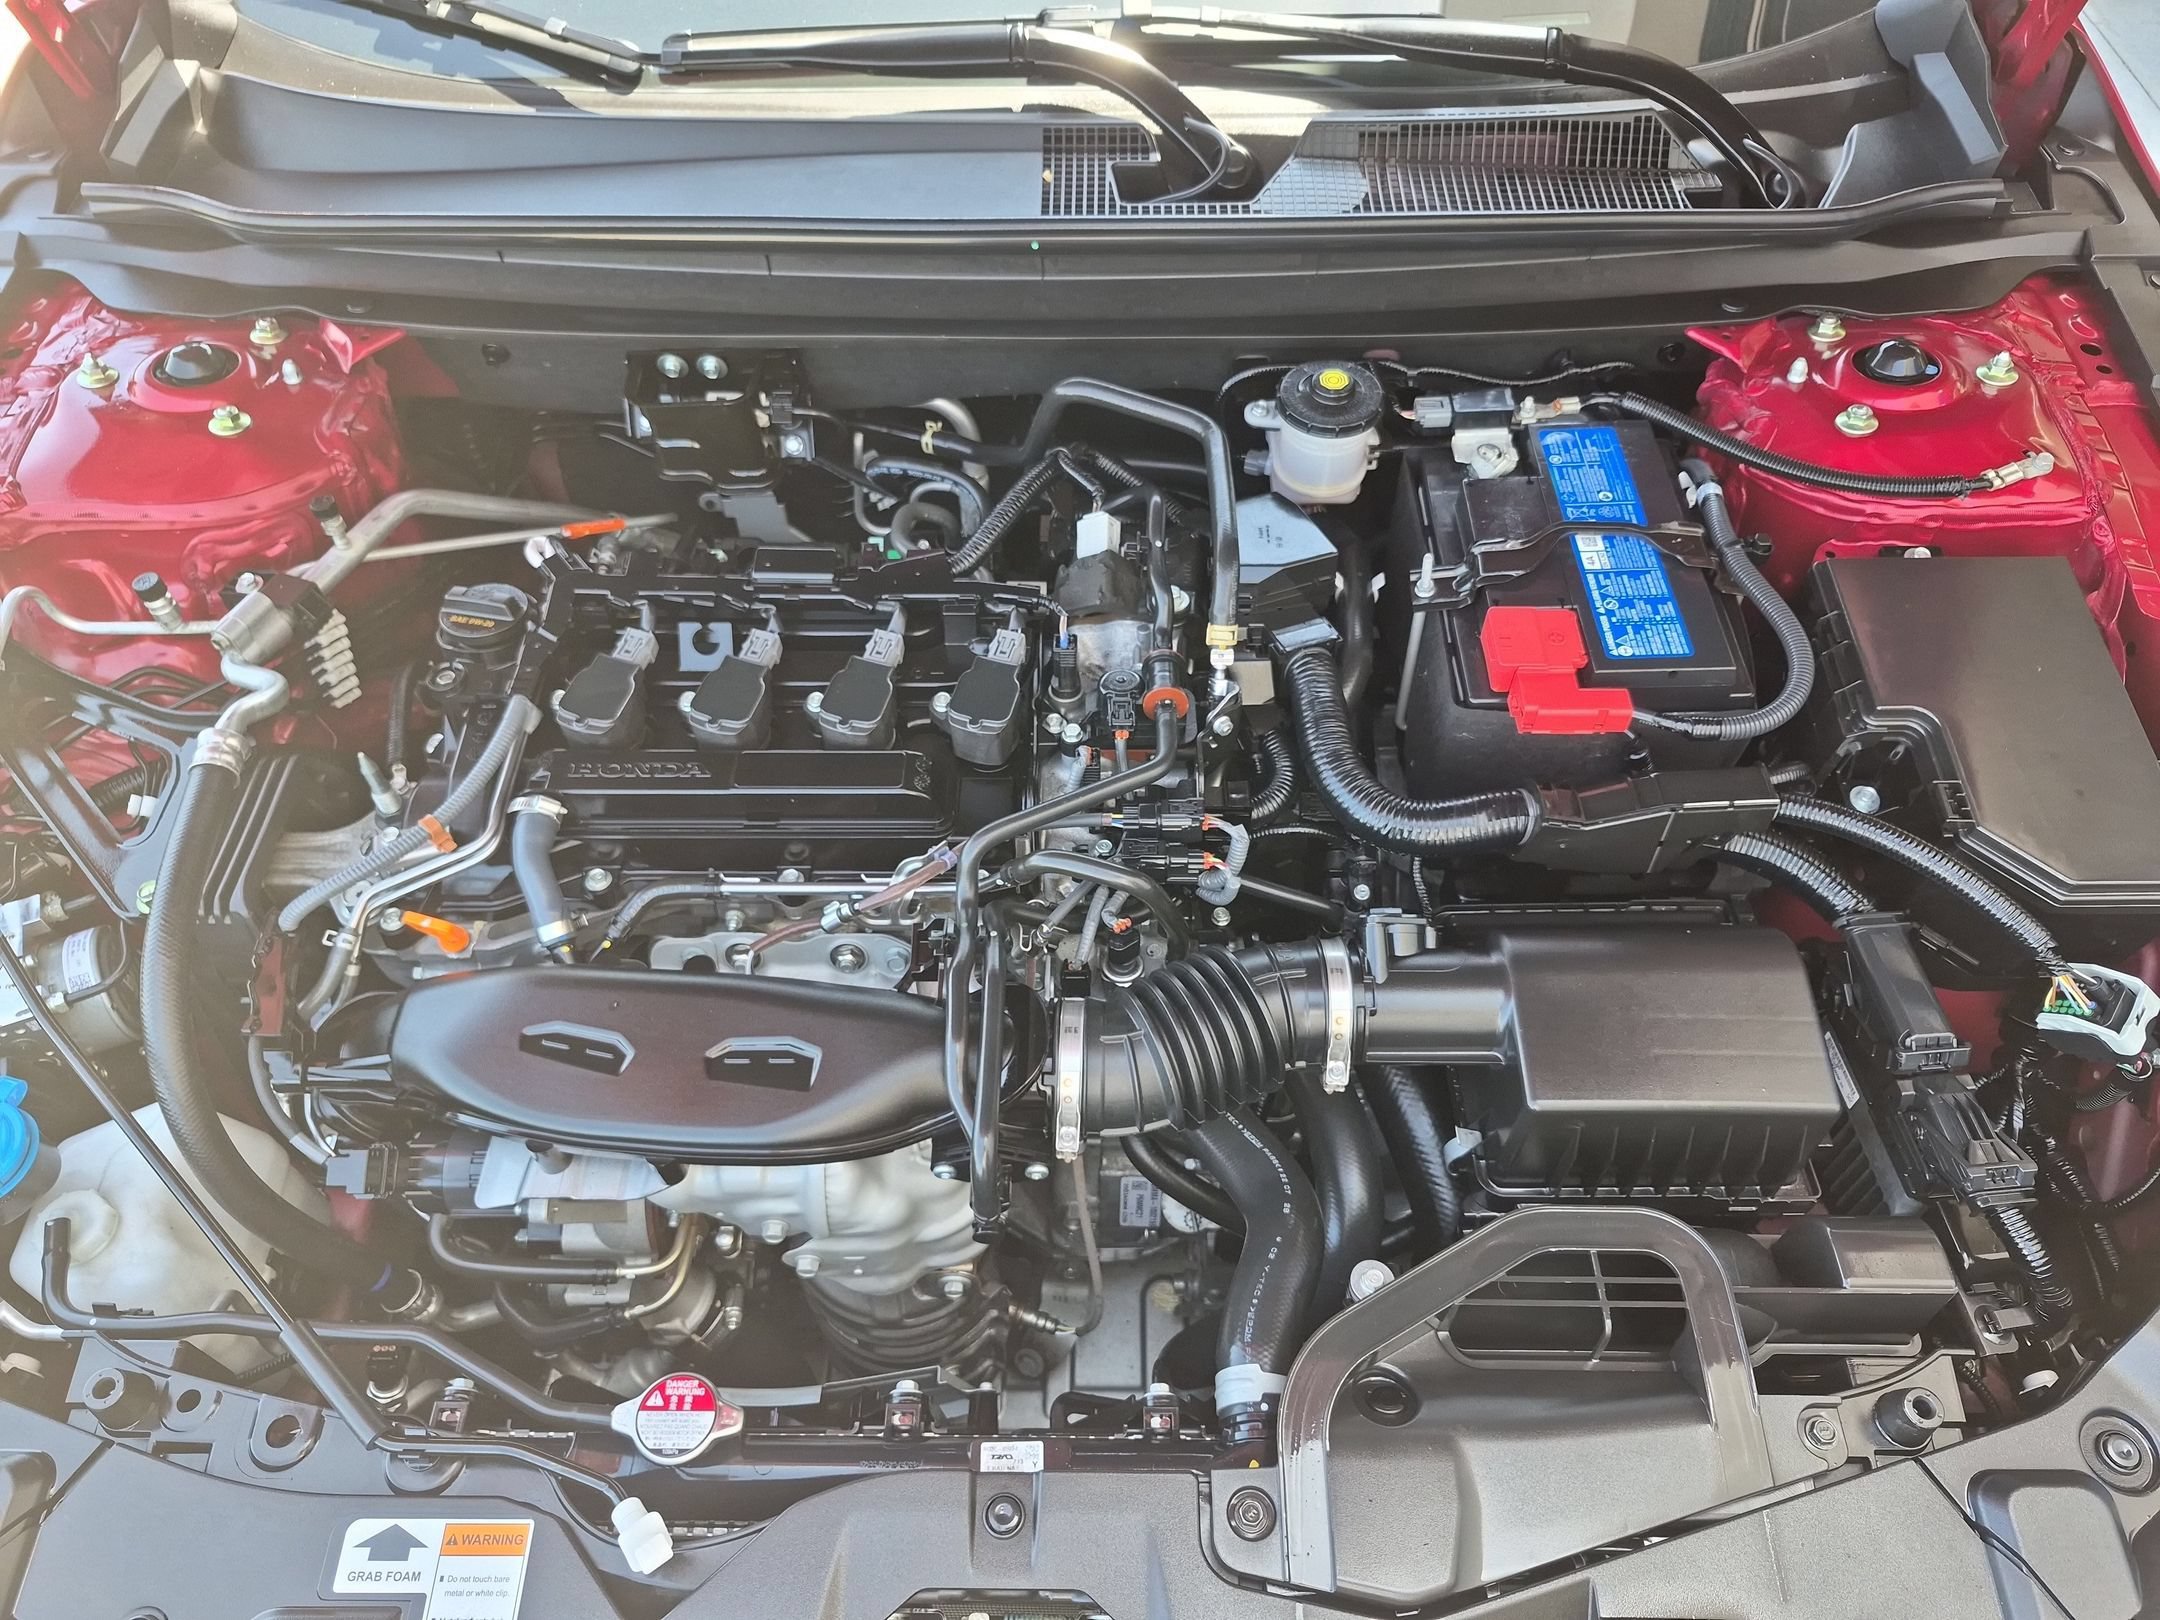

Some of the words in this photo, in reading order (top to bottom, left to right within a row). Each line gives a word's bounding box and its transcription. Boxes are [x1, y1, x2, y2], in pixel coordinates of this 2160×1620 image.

[567, 760, 713, 779] HONDA
[665, 1379, 699, 1388] DANGER
[665, 1387, 706, 1396] WARNUNG
[462, 1534, 524, 1546] WARNING
[347, 1571, 383, 1582] GRAB
[386, 1571, 421, 1582] FOAM
[447, 1575, 459, 1583] Do
[459, 1575, 472, 1583] not
[473, 1575, 493, 1583] touch
[494, 1575, 511, 1583] bare
[444, 1589, 464, 1597] metal
[475, 1589, 494, 1597] white
[495, 1589, 511, 1599] clip.
